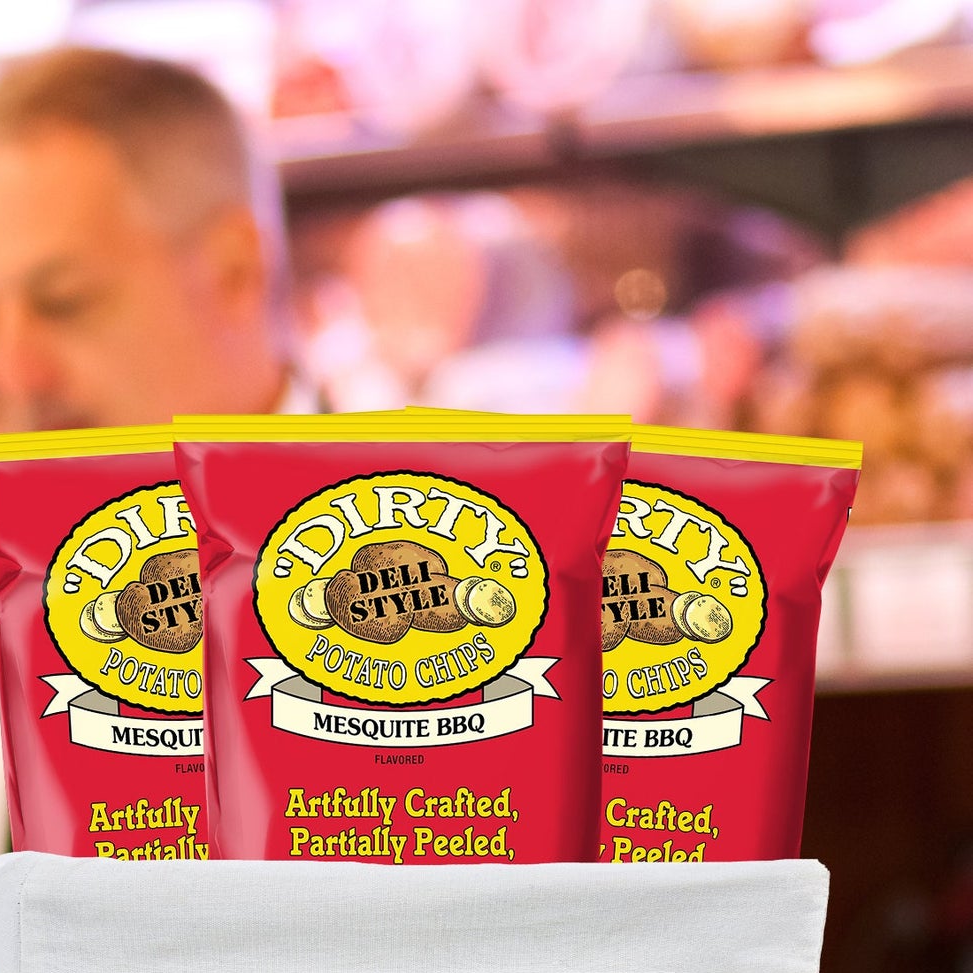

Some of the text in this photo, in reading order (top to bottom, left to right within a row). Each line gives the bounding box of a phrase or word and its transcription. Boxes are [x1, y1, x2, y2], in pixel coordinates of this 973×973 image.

[357, 561, 432, 595] DELI
[349, 585, 449, 624] STYLE
[100, 648, 202, 699] POTATO
[306, 632, 495, 690] POTATO CHIPS
[627, 647, 708, 699] CHIPS
[313, 712, 485, 740] MESQUITE BBQ
[644, 727, 693, 748] BBQ
[374, 755, 425, 765] FLAVORED
[89, 796, 200, 835] Artfully
[284, 787, 519, 826] Artfully Crafted,
[605, 798, 720, 839] Crafted,
[289, 826, 515, 864] Partially Peeled,
